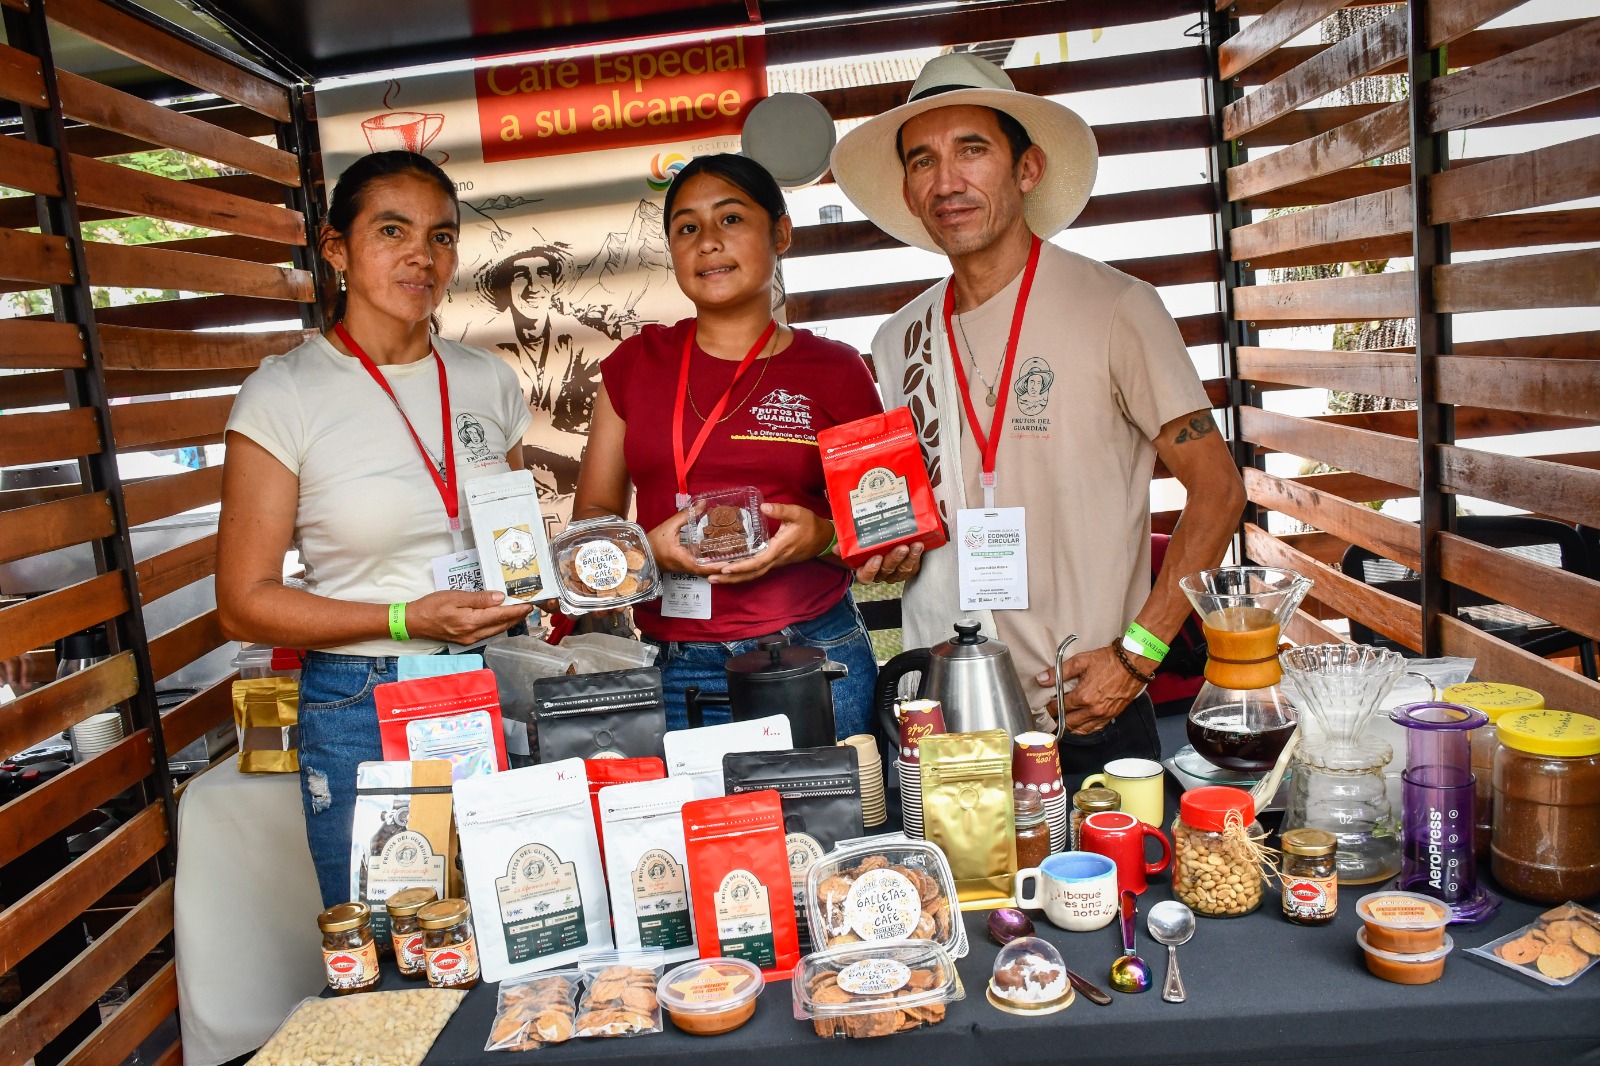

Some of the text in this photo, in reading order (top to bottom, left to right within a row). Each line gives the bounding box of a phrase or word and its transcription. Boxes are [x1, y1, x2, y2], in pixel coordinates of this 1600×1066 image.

[487, 34, 746, 96] Café Especial
[500, 88, 742, 142] a su alcance
[751, 406, 813, 419] FRUTOS DEL
[582, 553, 618, 566] GALLETAS
[597, 562, 609, 571] DE
[907, 723, 934, 736] Café
[1339, 814, 1354, 825] 02
[383, 842, 396, 865] FRUTOS
[397, 835, 410, 843] DEL
[799, 838, 819, 860] GUARDI
[1428, 810, 1442, 890] AeroPress
[511, 848, 559, 885] FRUTOS DEL GUARDIÁN
[638, 860, 647, 882] FRUTOS
[646, 852, 657, 861] DEL
[856, 888, 907, 908] GALLETAS
[1064, 900, 1102, 909] es una
[878, 902, 893, 914] DE
[1073, 909, 1100, 917] nota
